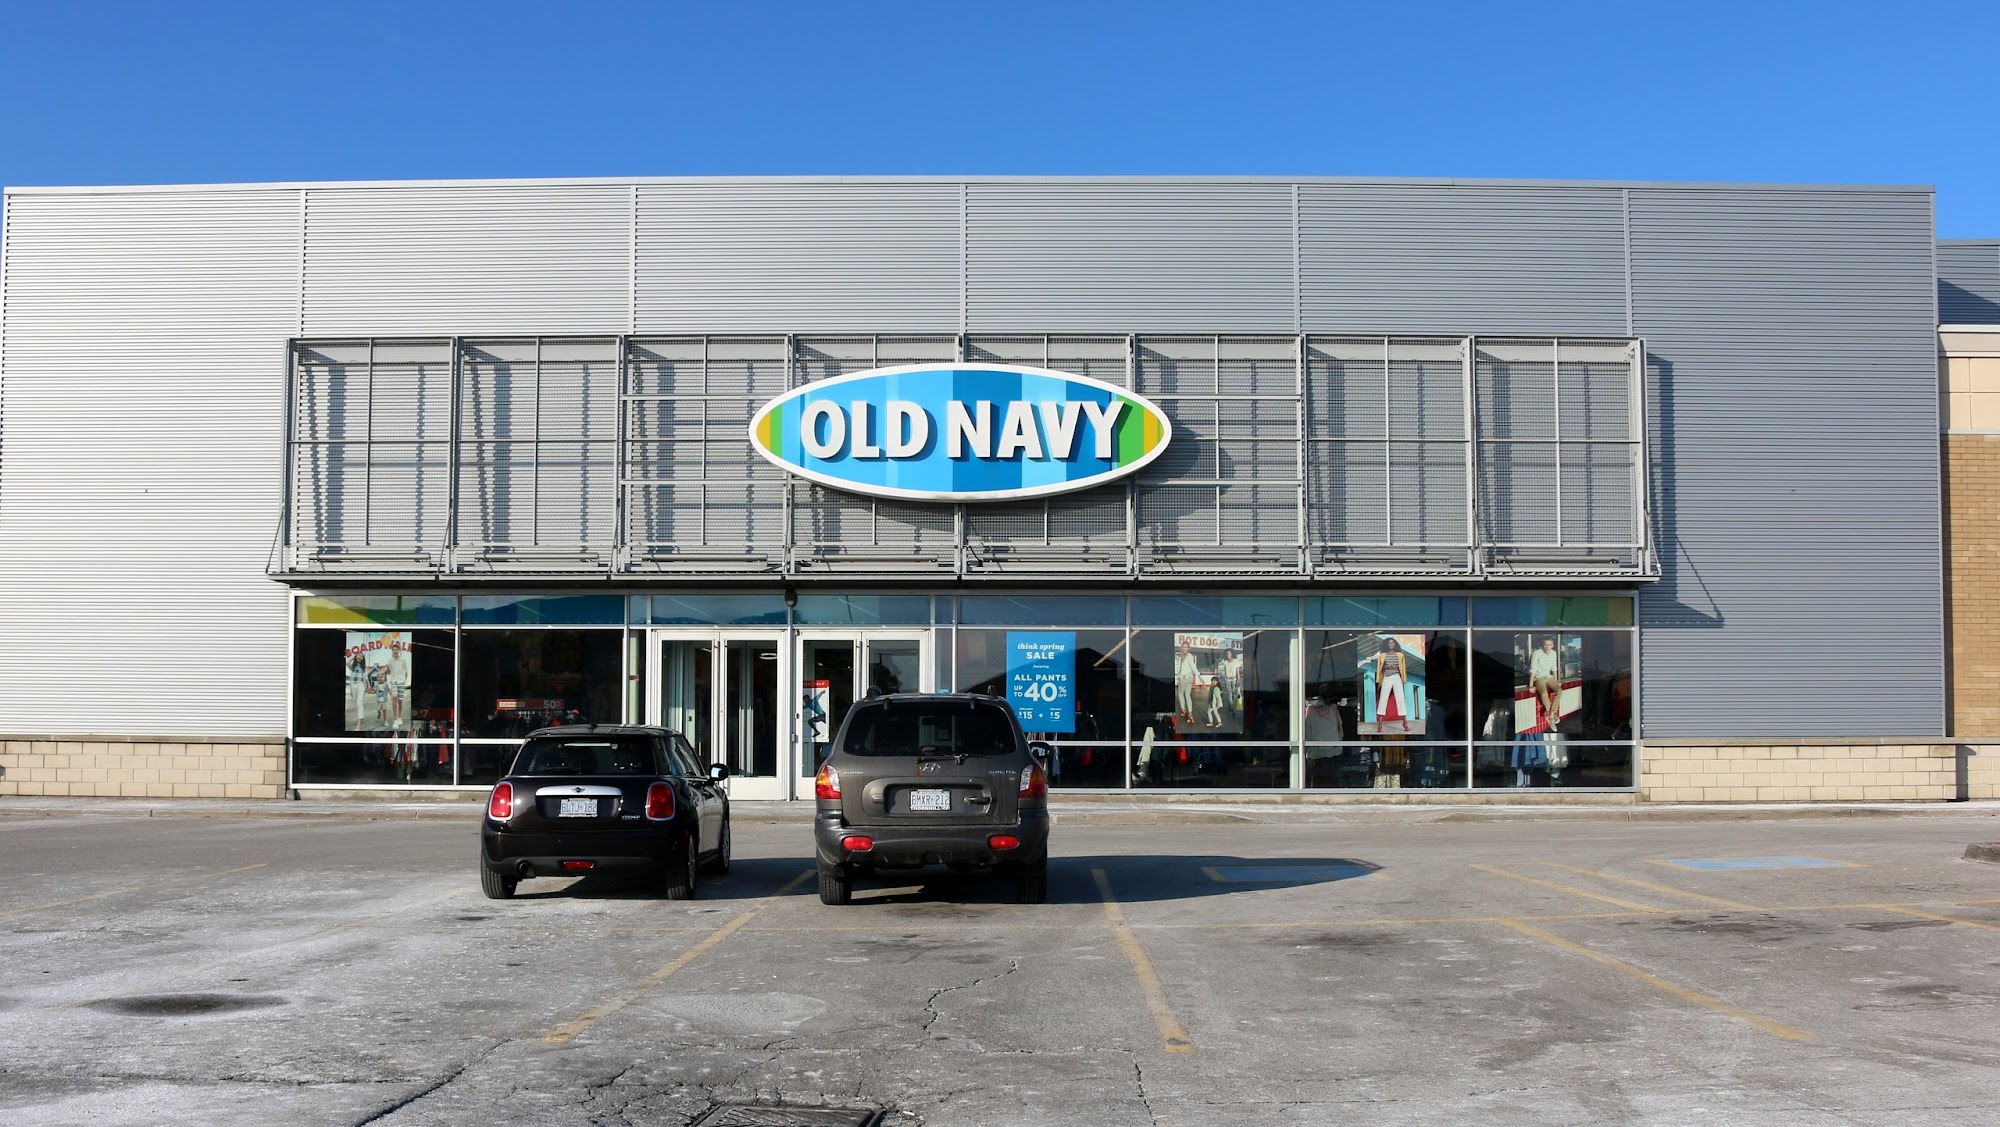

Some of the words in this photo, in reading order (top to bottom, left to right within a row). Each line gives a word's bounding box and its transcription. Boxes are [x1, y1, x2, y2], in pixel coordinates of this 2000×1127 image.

[800, 399, 929, 459] OLD
[946, 400, 1125, 459] NAVY
[1178, 635, 1198, 646] HOT
[1199, 637, 1218, 647] DOG
[1039, 643, 1065, 651] spring
[1026, 651, 1055, 660] SALE
[1018, 711, 1033, 720] $15
[1050, 711, 1060, 720] $5
[911, 794, 931, 805] BMXR
[935, 794, 950, 805] 212
[584, 802, 597, 813] 182
